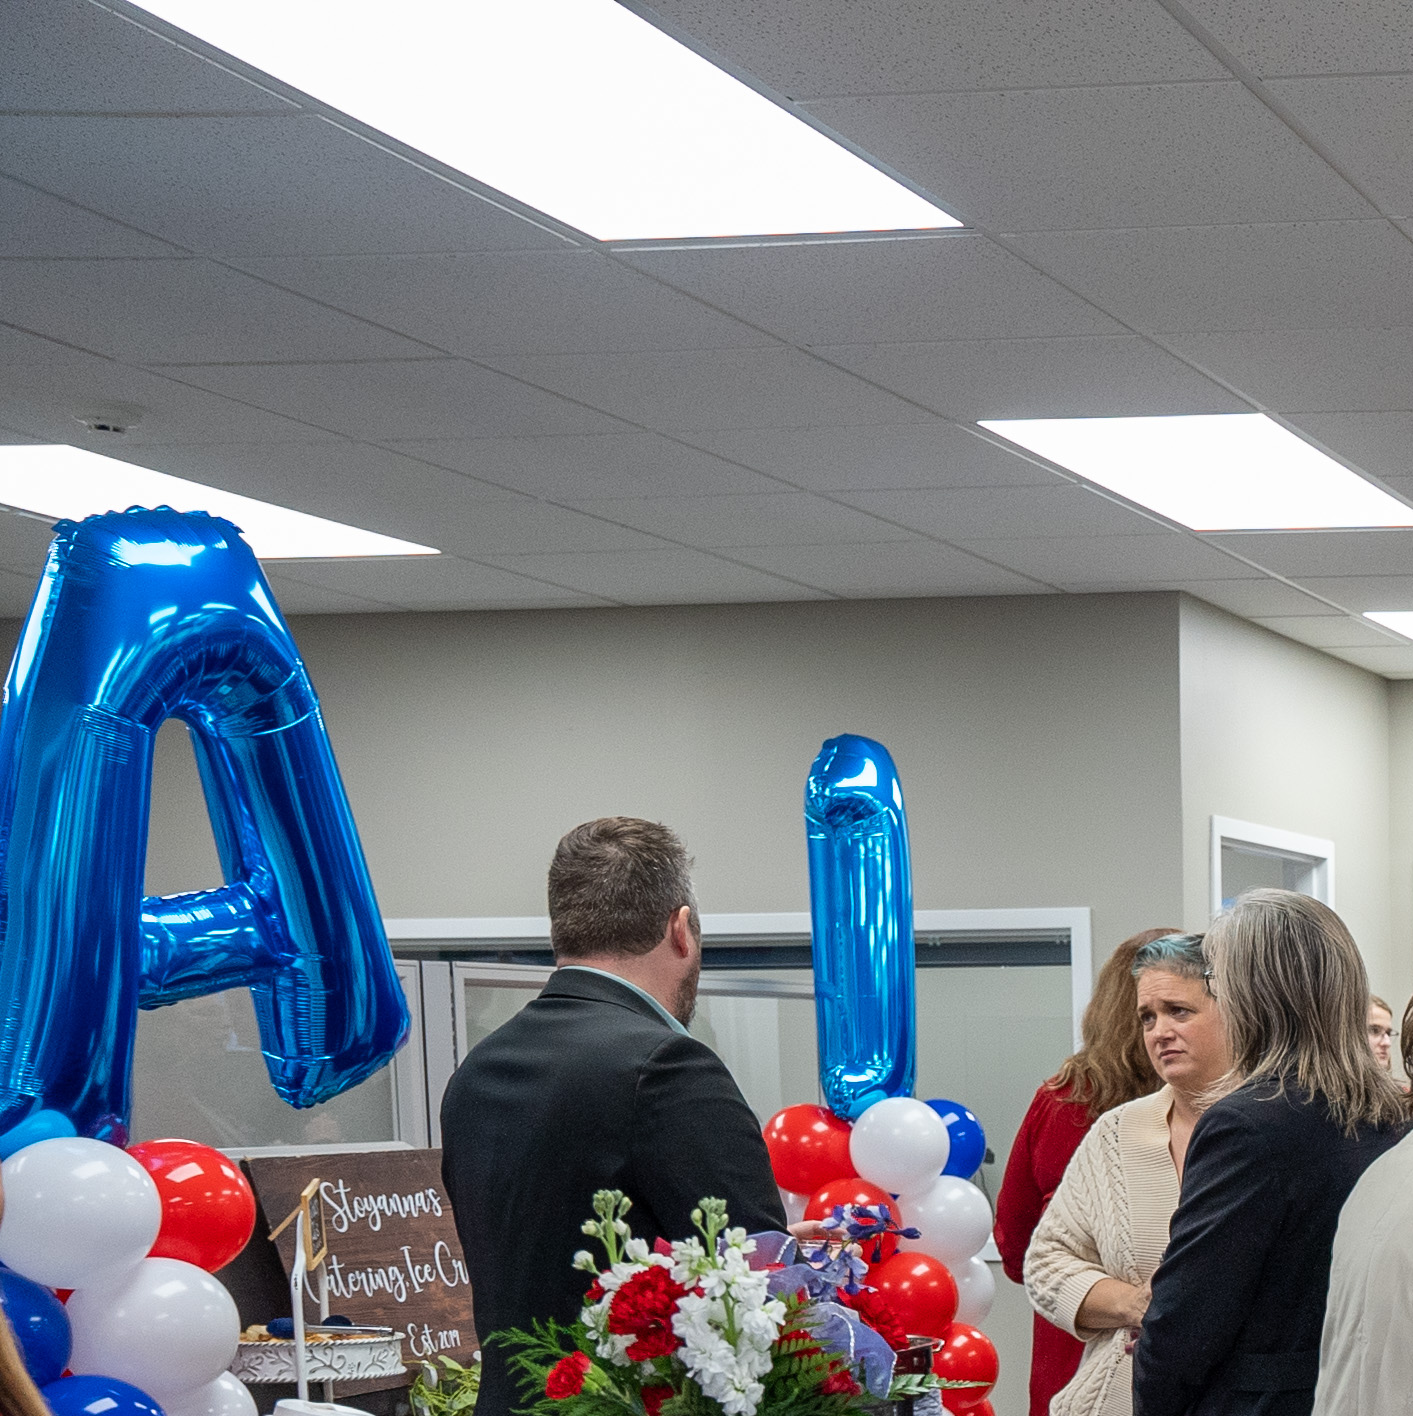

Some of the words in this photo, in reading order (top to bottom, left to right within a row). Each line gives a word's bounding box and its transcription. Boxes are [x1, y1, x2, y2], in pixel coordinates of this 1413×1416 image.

[319, 1178, 443, 1233] Stoyanna's
[400, 1245, 436, 1294] Ice
[407, 1322, 439, 1357] Est
[437, 1328, 461, 1351] 2019
